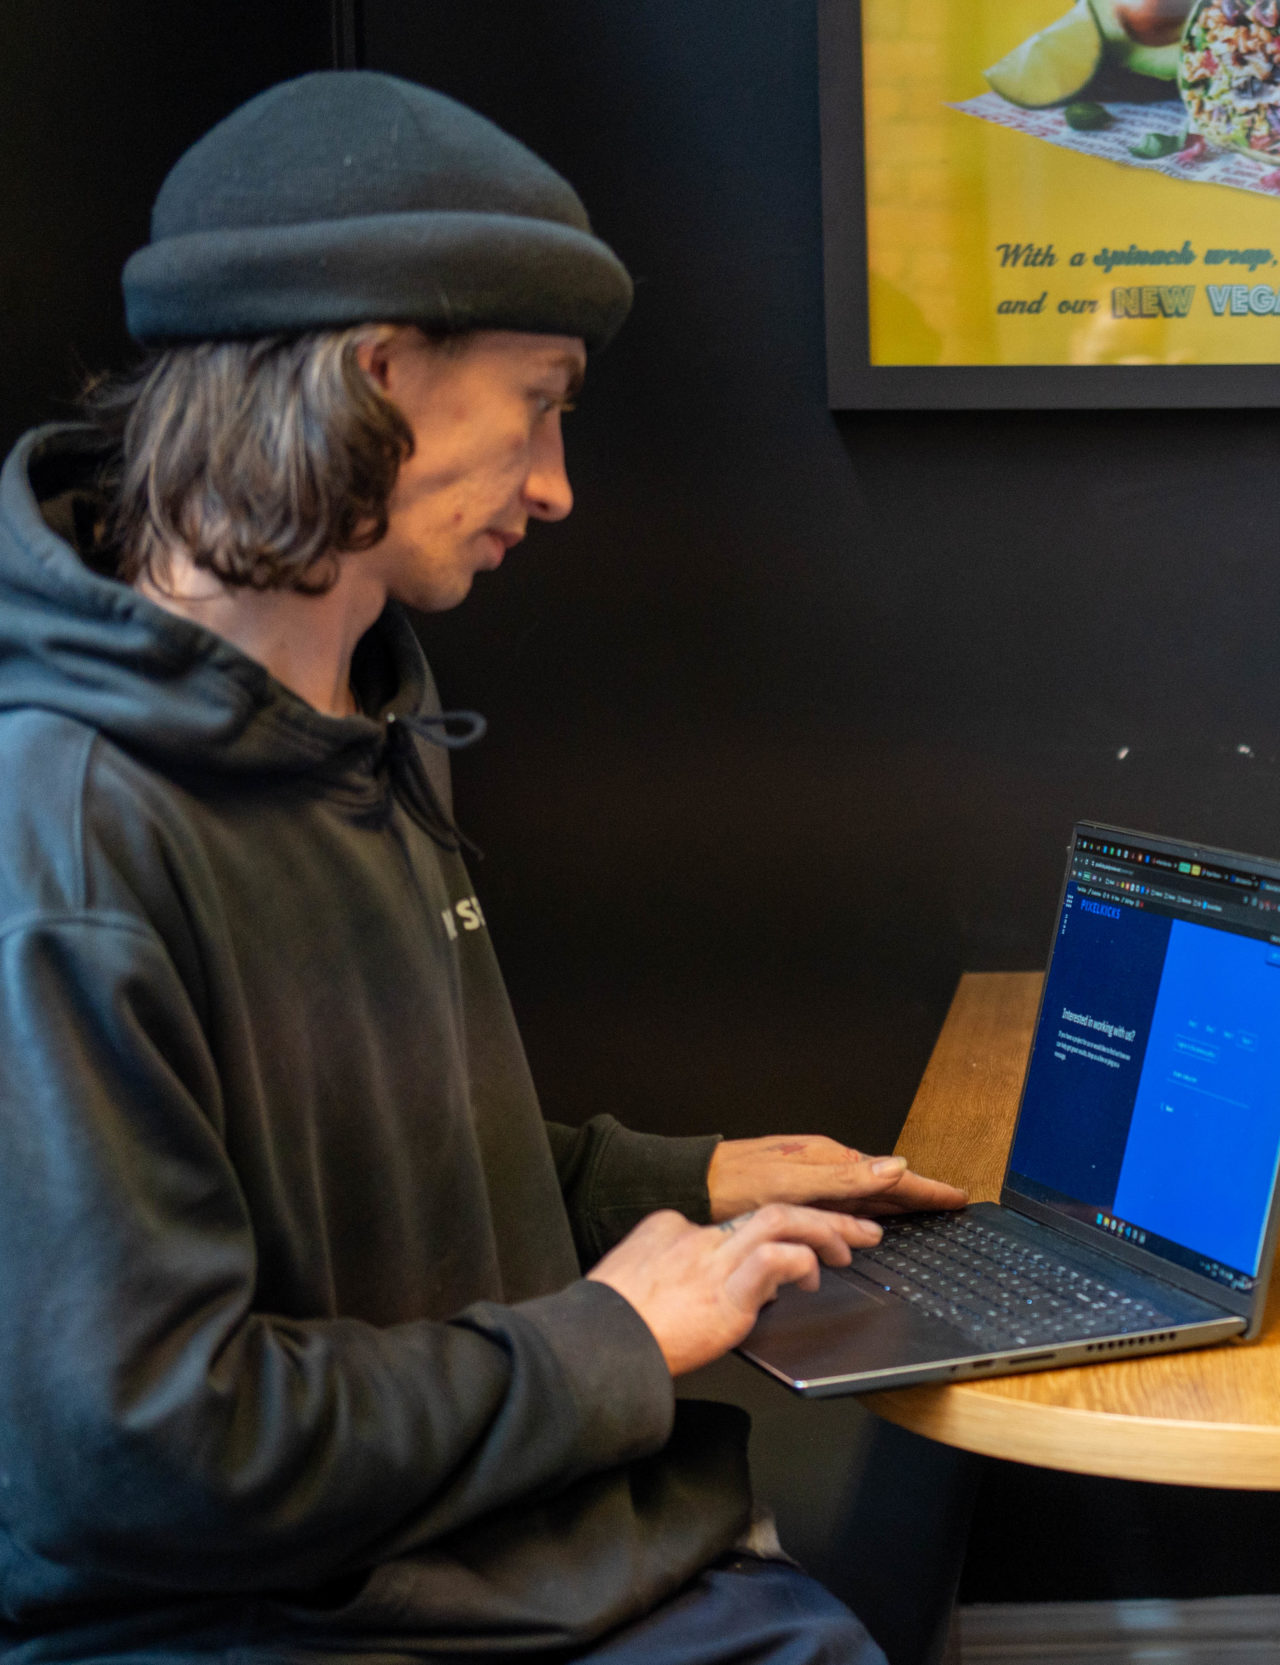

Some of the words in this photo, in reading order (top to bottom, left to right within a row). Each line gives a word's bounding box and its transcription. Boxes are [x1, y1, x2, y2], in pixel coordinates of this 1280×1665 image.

[996, 243, 1057, 268] With
[1069, 252, 1087, 267] a
[1093, 240, 1197, 274] spinach
[997, 291, 1048, 315] and
[1057, 299, 1100, 315] our
[1111, 285, 1196, 319] NEW
